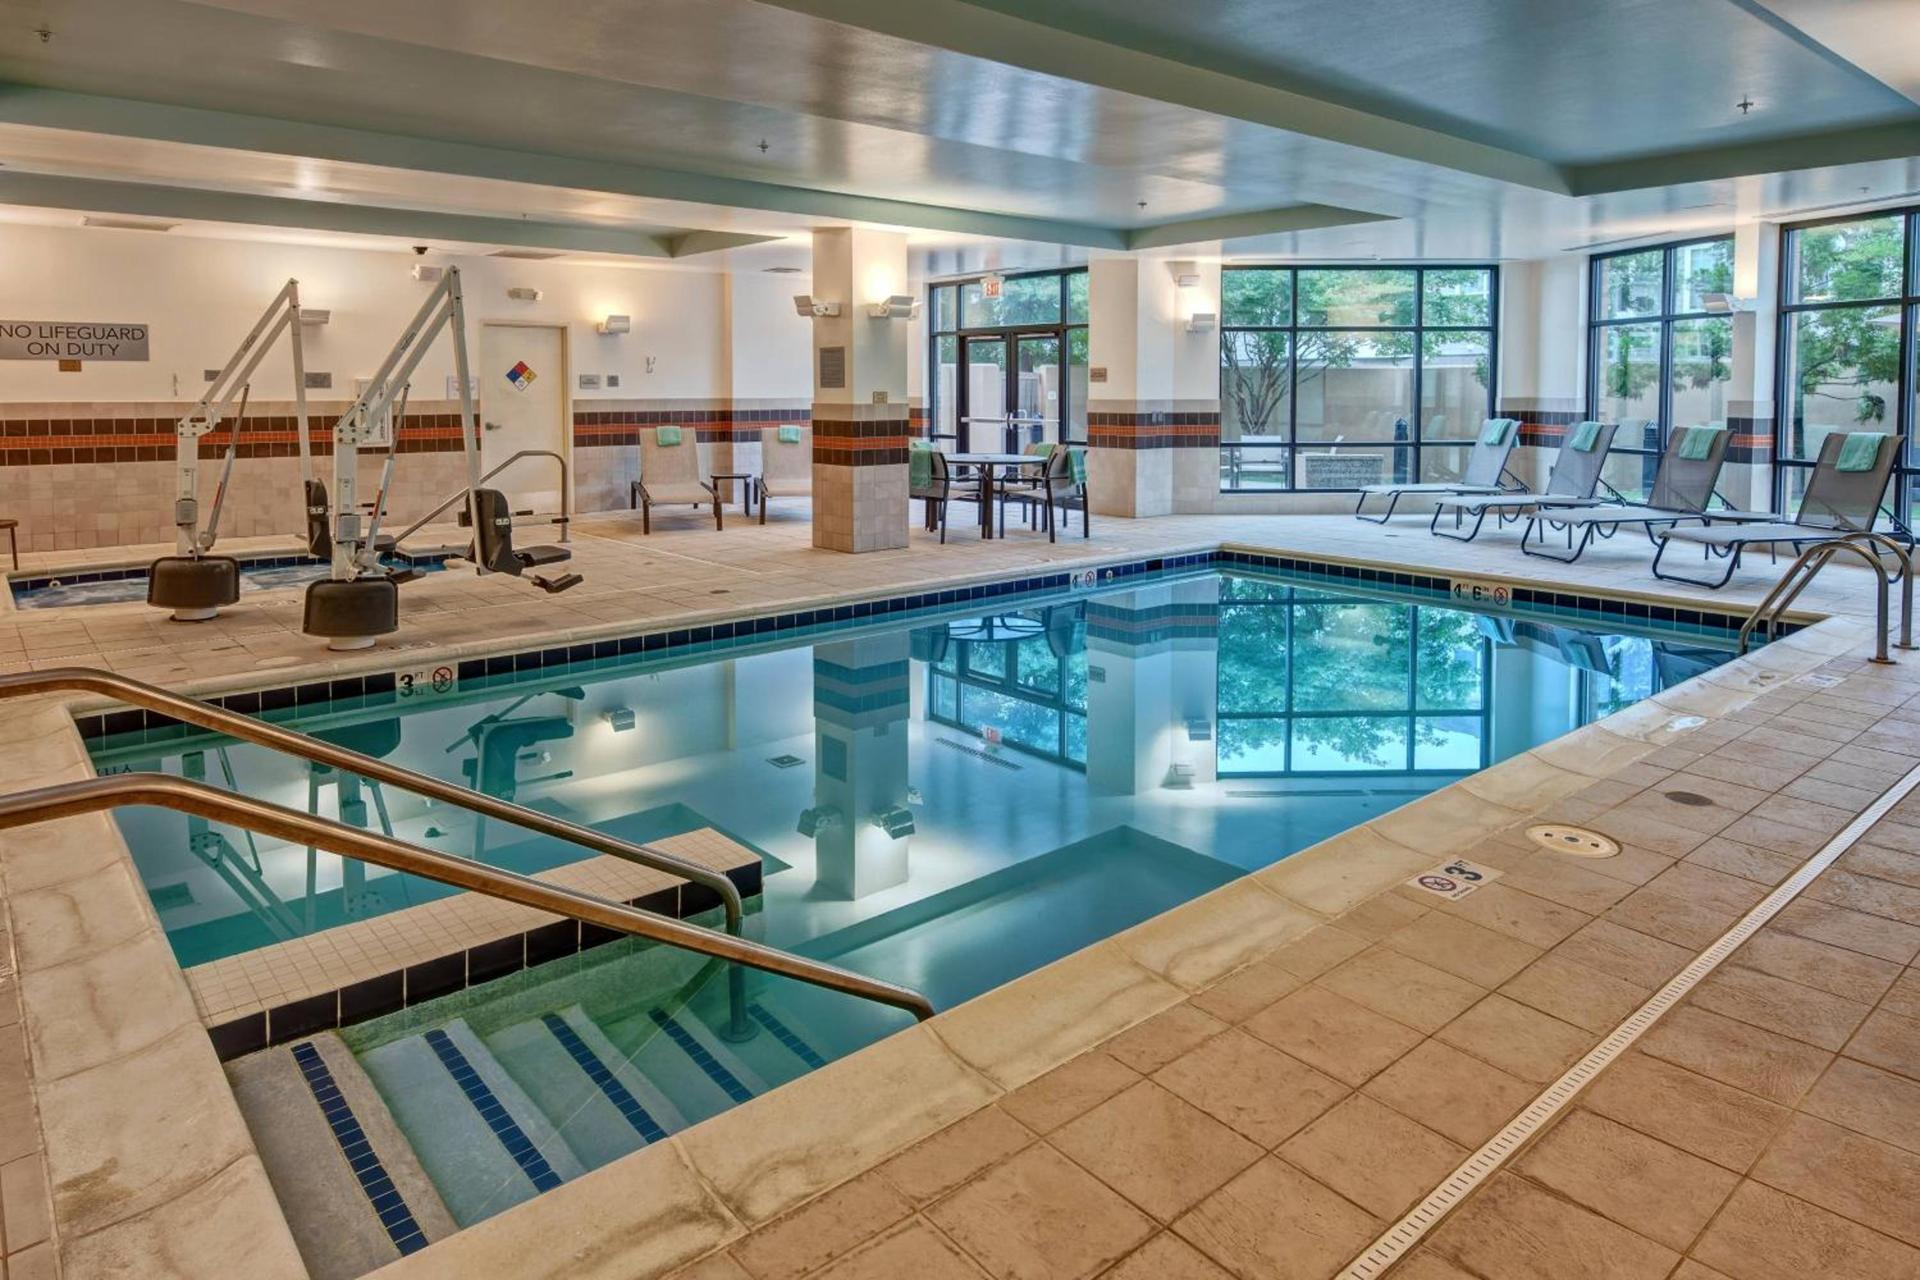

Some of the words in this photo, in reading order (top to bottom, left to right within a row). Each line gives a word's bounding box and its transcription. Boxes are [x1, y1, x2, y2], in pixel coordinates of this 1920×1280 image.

[0, 325, 32, 339] NO
[39, 326, 145, 341] LIFEGUARD
[27, 342, 60, 356] ON
[67, 343, 119, 357] DUTY
[1445, 866, 1483, 881] 3
